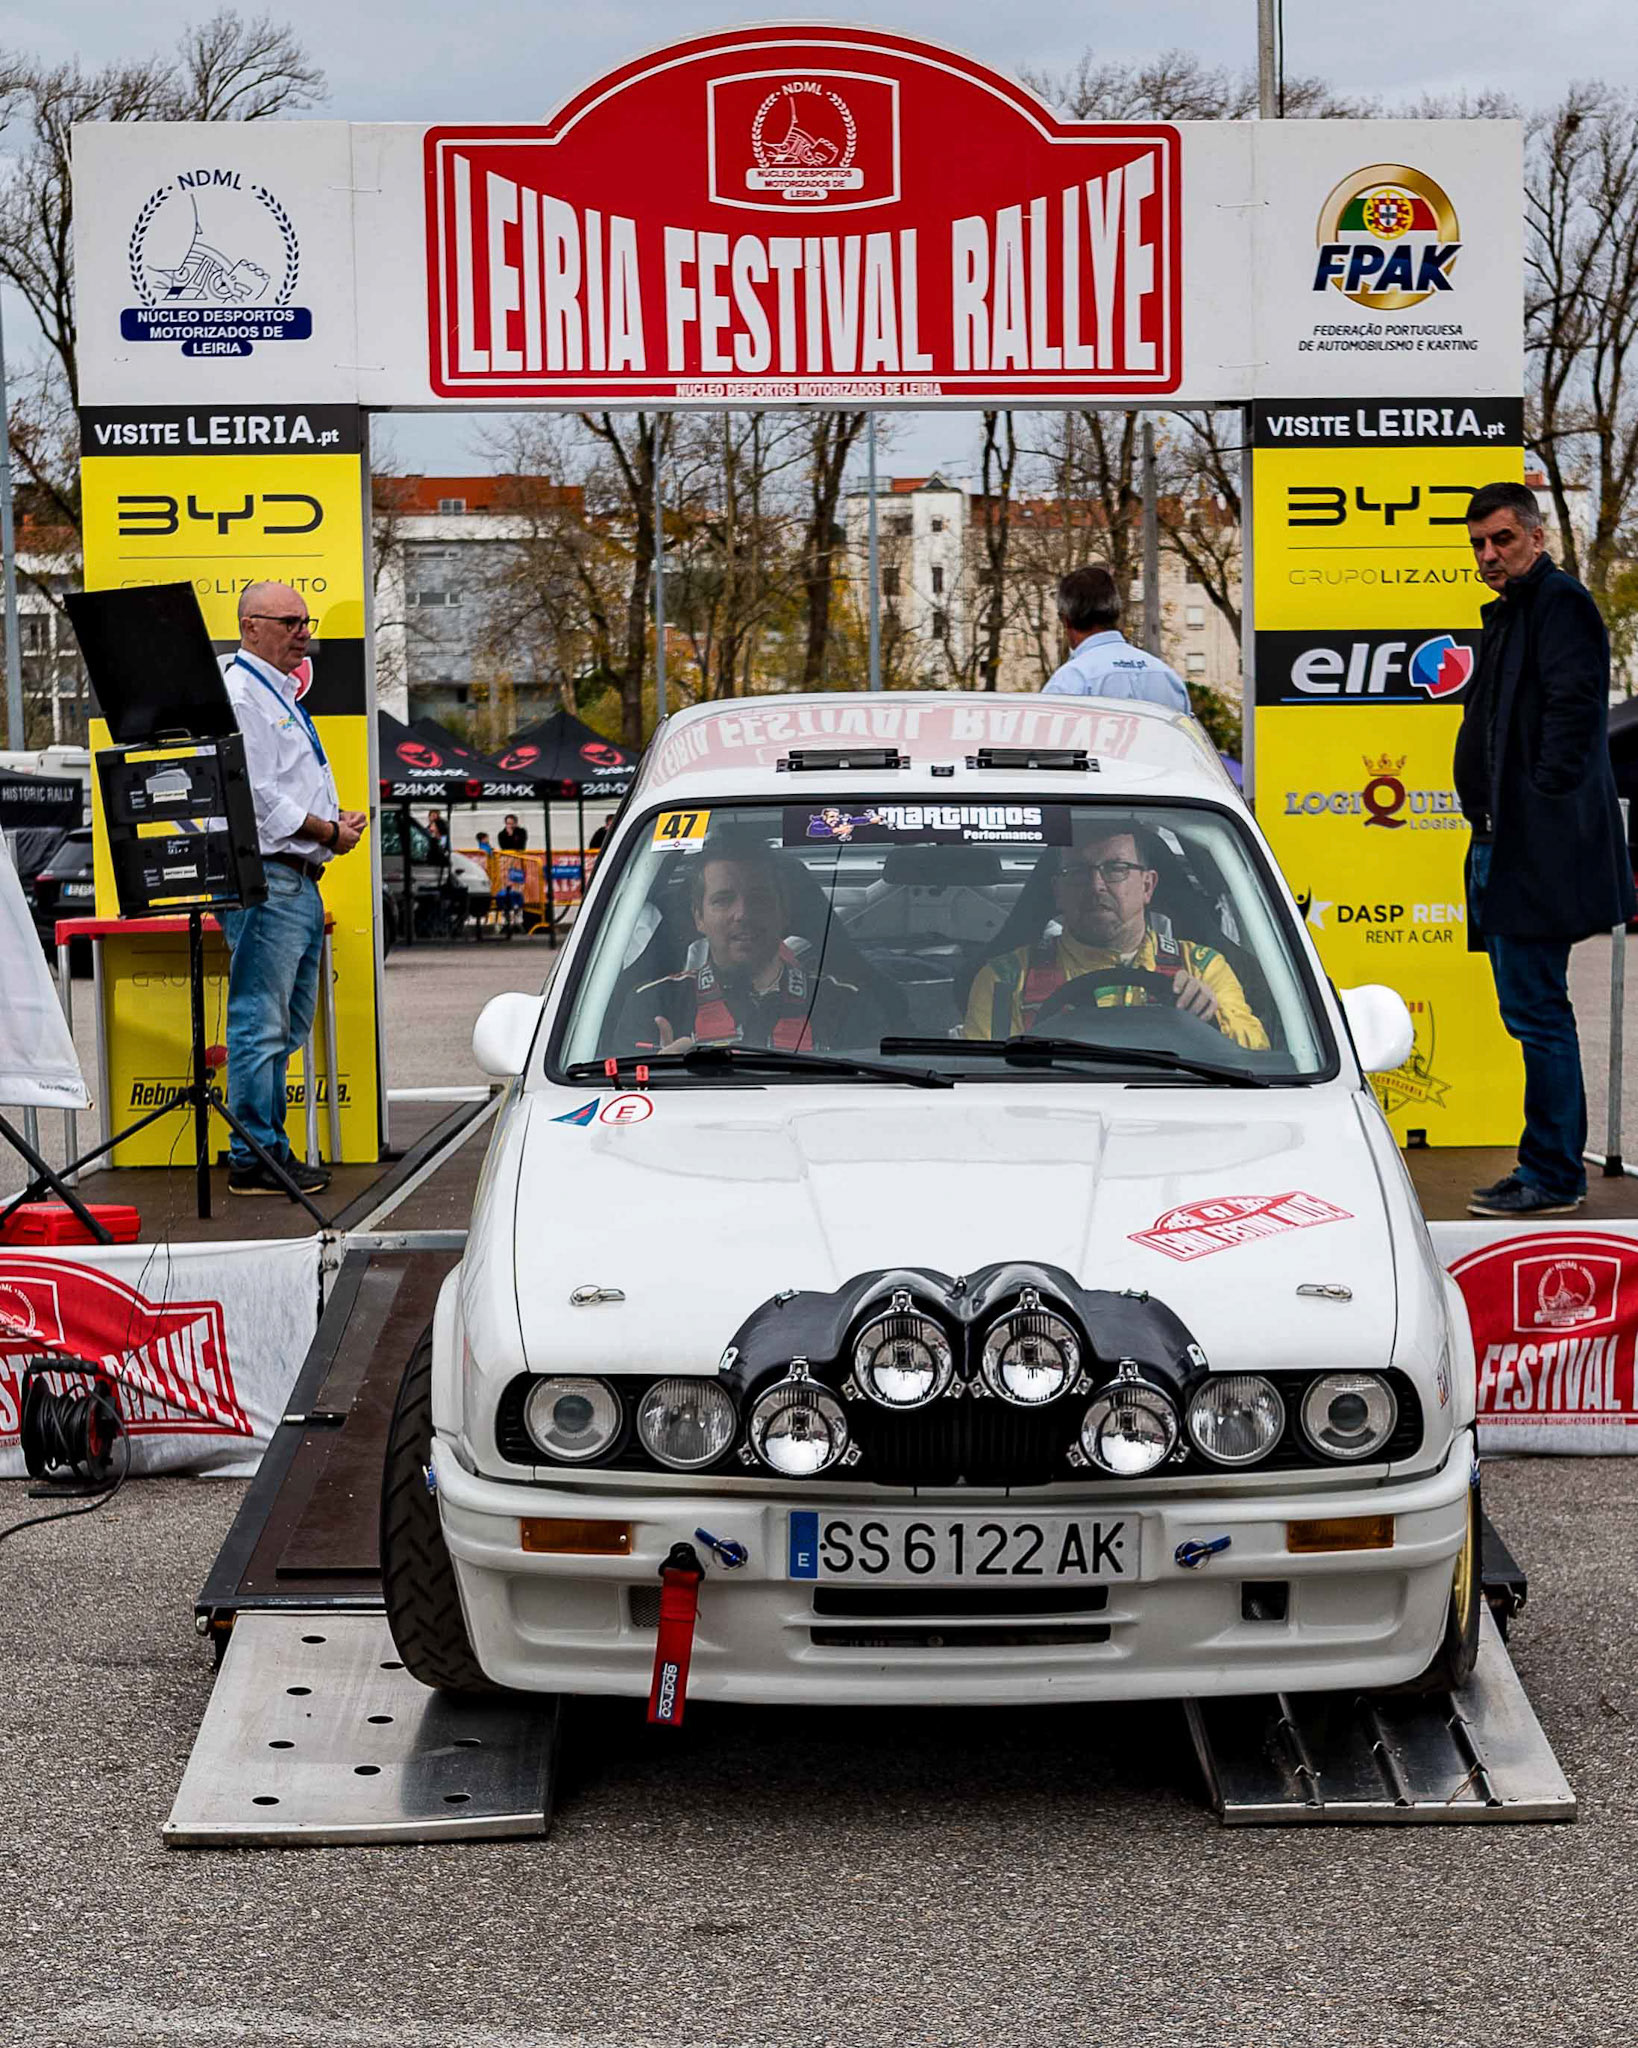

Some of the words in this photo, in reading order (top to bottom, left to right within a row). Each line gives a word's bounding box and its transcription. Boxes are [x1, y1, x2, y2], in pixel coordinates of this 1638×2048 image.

[782, 82, 822, 95] NDML
[177, 169, 242, 190] NDML
[833, 180, 846, 188] DE
[790, 190, 820, 198] LEIRIA
[454, 153, 646, 373] LEIRIA
[664, 226, 933, 373] FESTIVAL
[952, 150, 1156, 371] RALLYE
[1312, 244, 1463, 291] FPAK
[138, 308, 200, 323] NÚCLEO
[203, 309, 295, 322] DESPORTOS
[150, 326, 260, 339] MOTORIZADOS
[263, 326, 284, 338] DE
[1313, 322, 1382, 337] FEDERAÇÃO
[1385, 324, 1463, 336] PORTUGUESA
[193, 342, 242, 355] LEIRIA
[1298, 340, 1314, 351] DE
[1316, 340, 1414, 351] AUTOMOBILISMO
[1416, 340, 1424, 351] E
[1427, 340, 1480, 351] KARTING
[727, 383, 797, 397] DESPORTOS
[799, 383, 883, 396] MOTORIZADOS
[885, 383, 901, 396] DE
[903, 383, 942, 396] LEIRIA
[1266, 415, 1350, 437] VISITE
[94, 423, 180, 445] VISITE
[118, 494, 324, 536] BYD
[1290, 642, 1407, 694] elf
[2, 786, 46, 802] HISTORIC
[47, 786, 75, 802] RALLY
[393, 783, 448, 797] 24MX
[483, 783, 536, 797] 24MX
[661, 813, 699, 839] 47
[963, 829, 1043, 841] Performance
[1337, 905, 1404, 923] DASP
[1366, 930, 1403, 943] RENT
[1408, 930, 1418, 943] A
[1422, 930, 1453, 943] CAR
[616, 1105, 637, 1119] E
[1476, 1335, 1622, 1411] FESTIVAL
[797, 1552, 810, 1567] E
